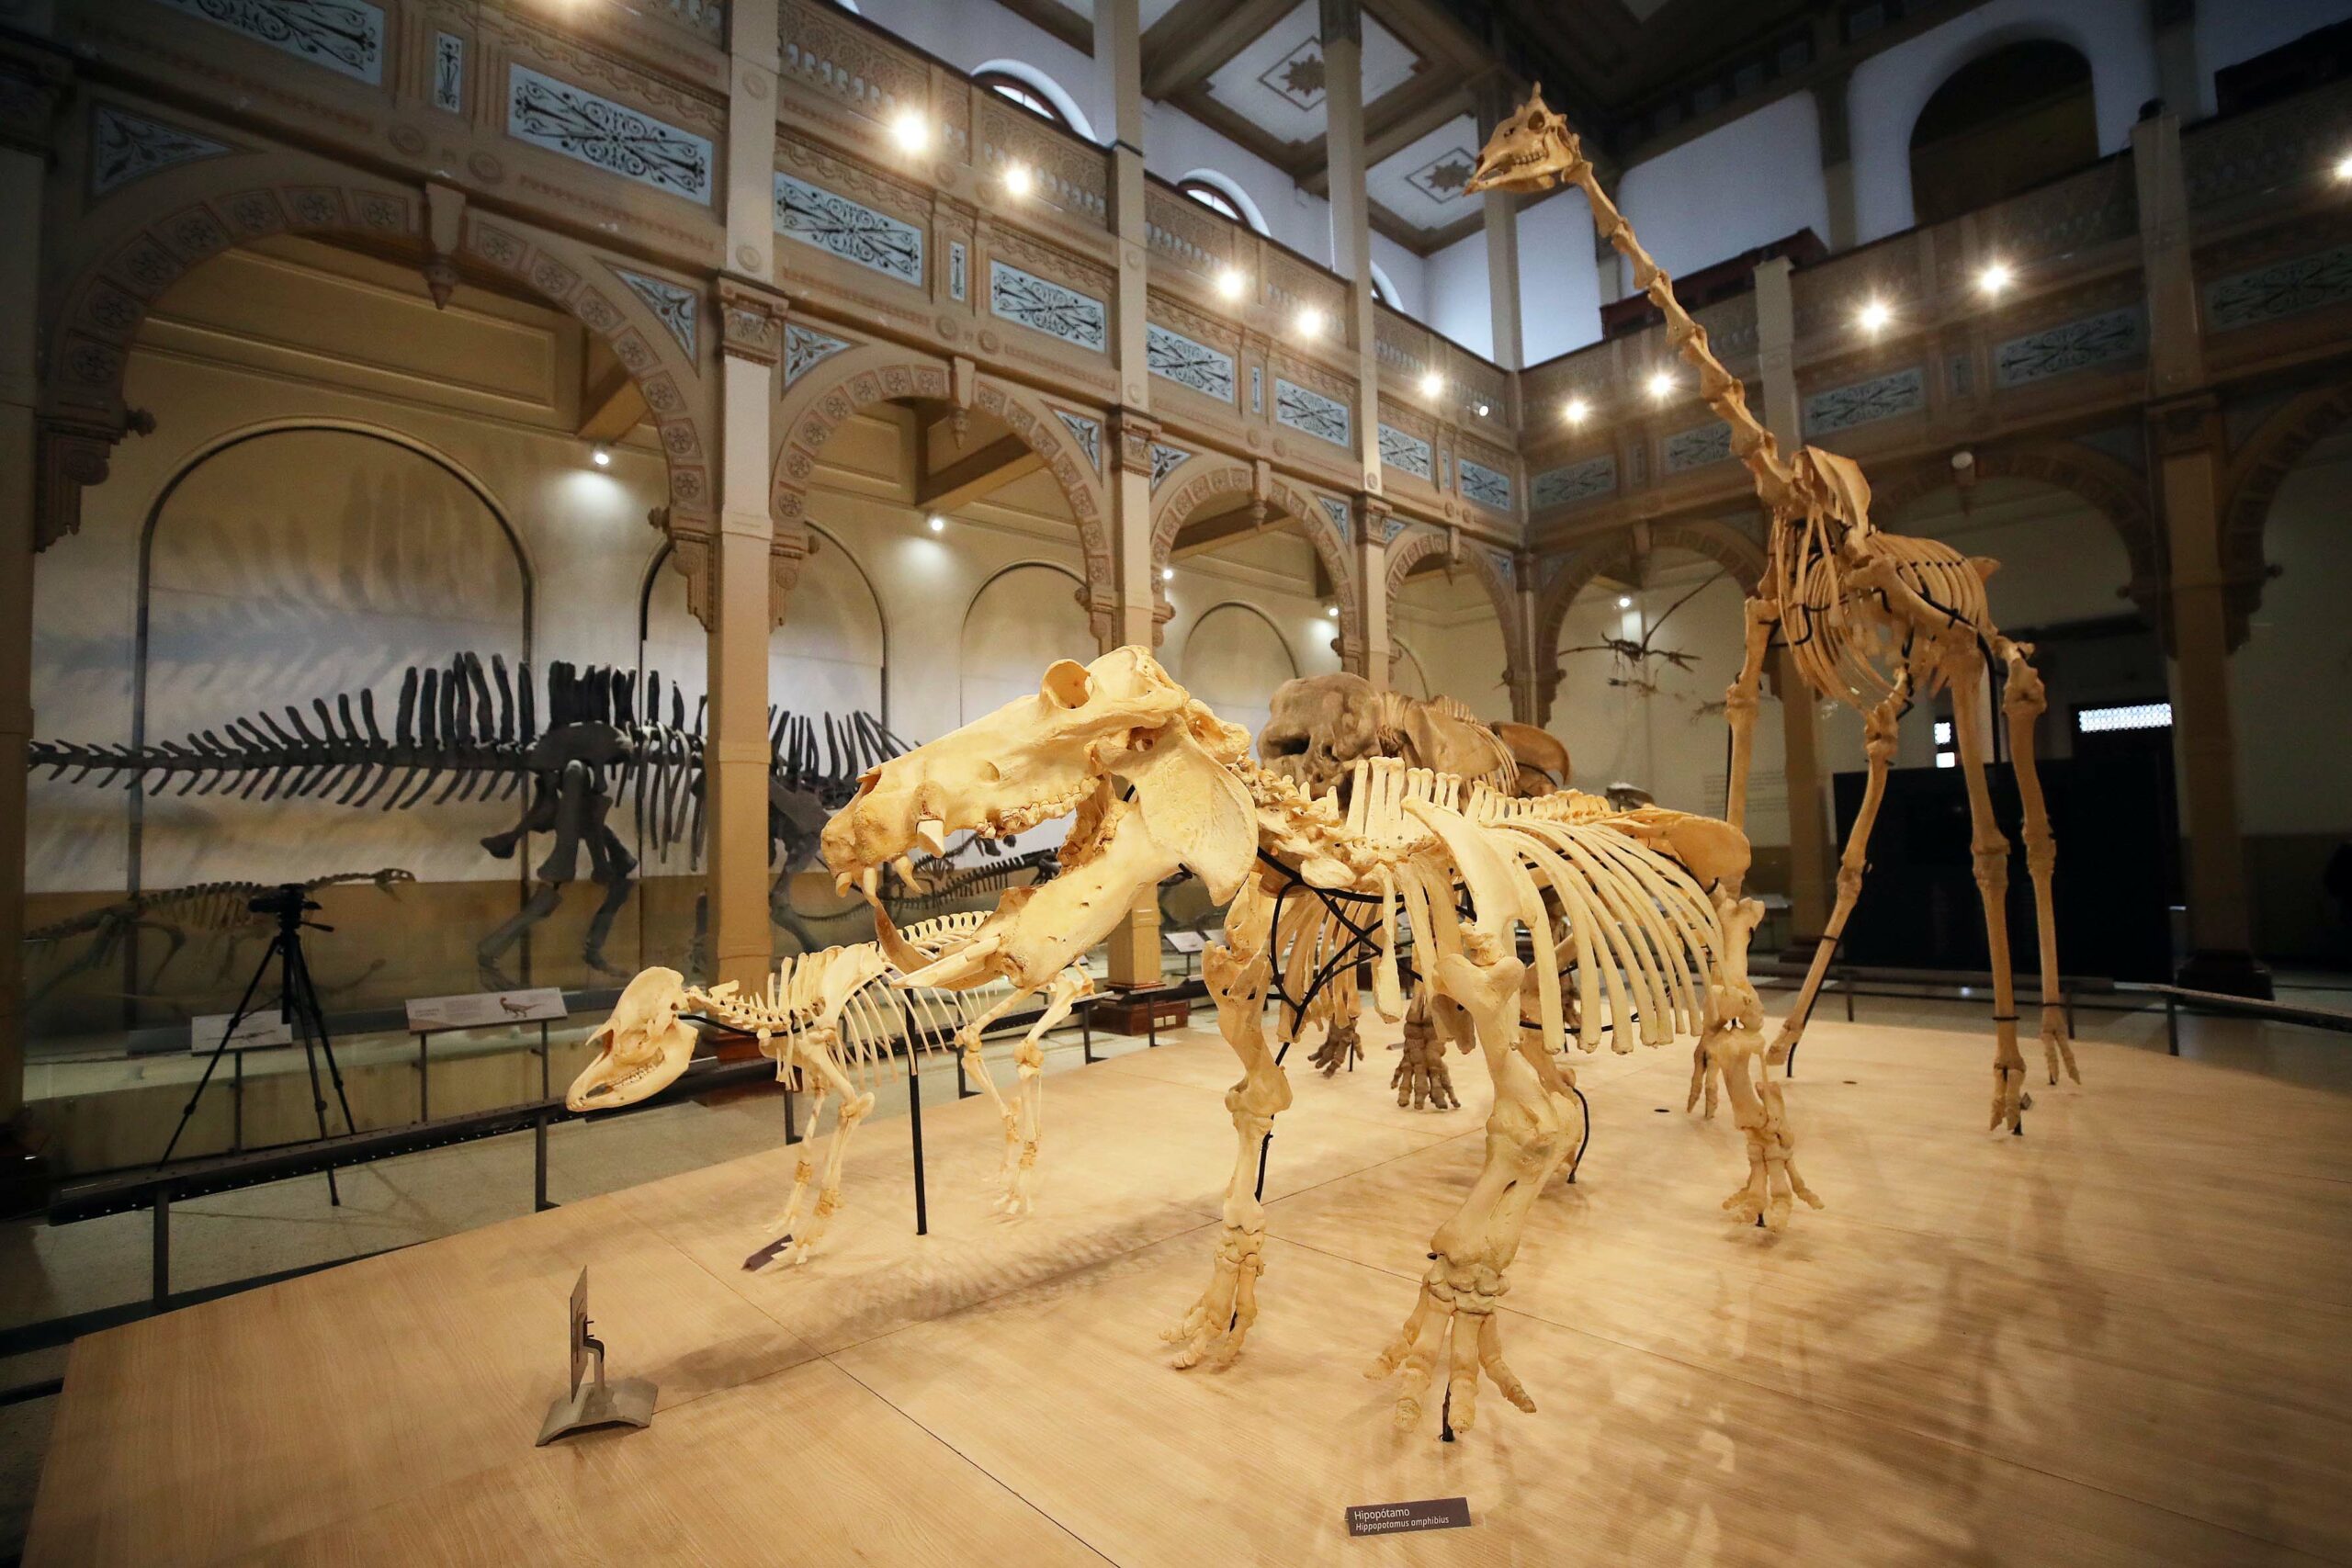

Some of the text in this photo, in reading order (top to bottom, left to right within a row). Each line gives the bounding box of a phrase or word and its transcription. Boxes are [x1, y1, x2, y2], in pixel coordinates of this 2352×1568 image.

[1354, 1507, 1410, 1522] Hipopótamo
[1356, 1516, 1450, 1532] Hippopotamus amphibius
